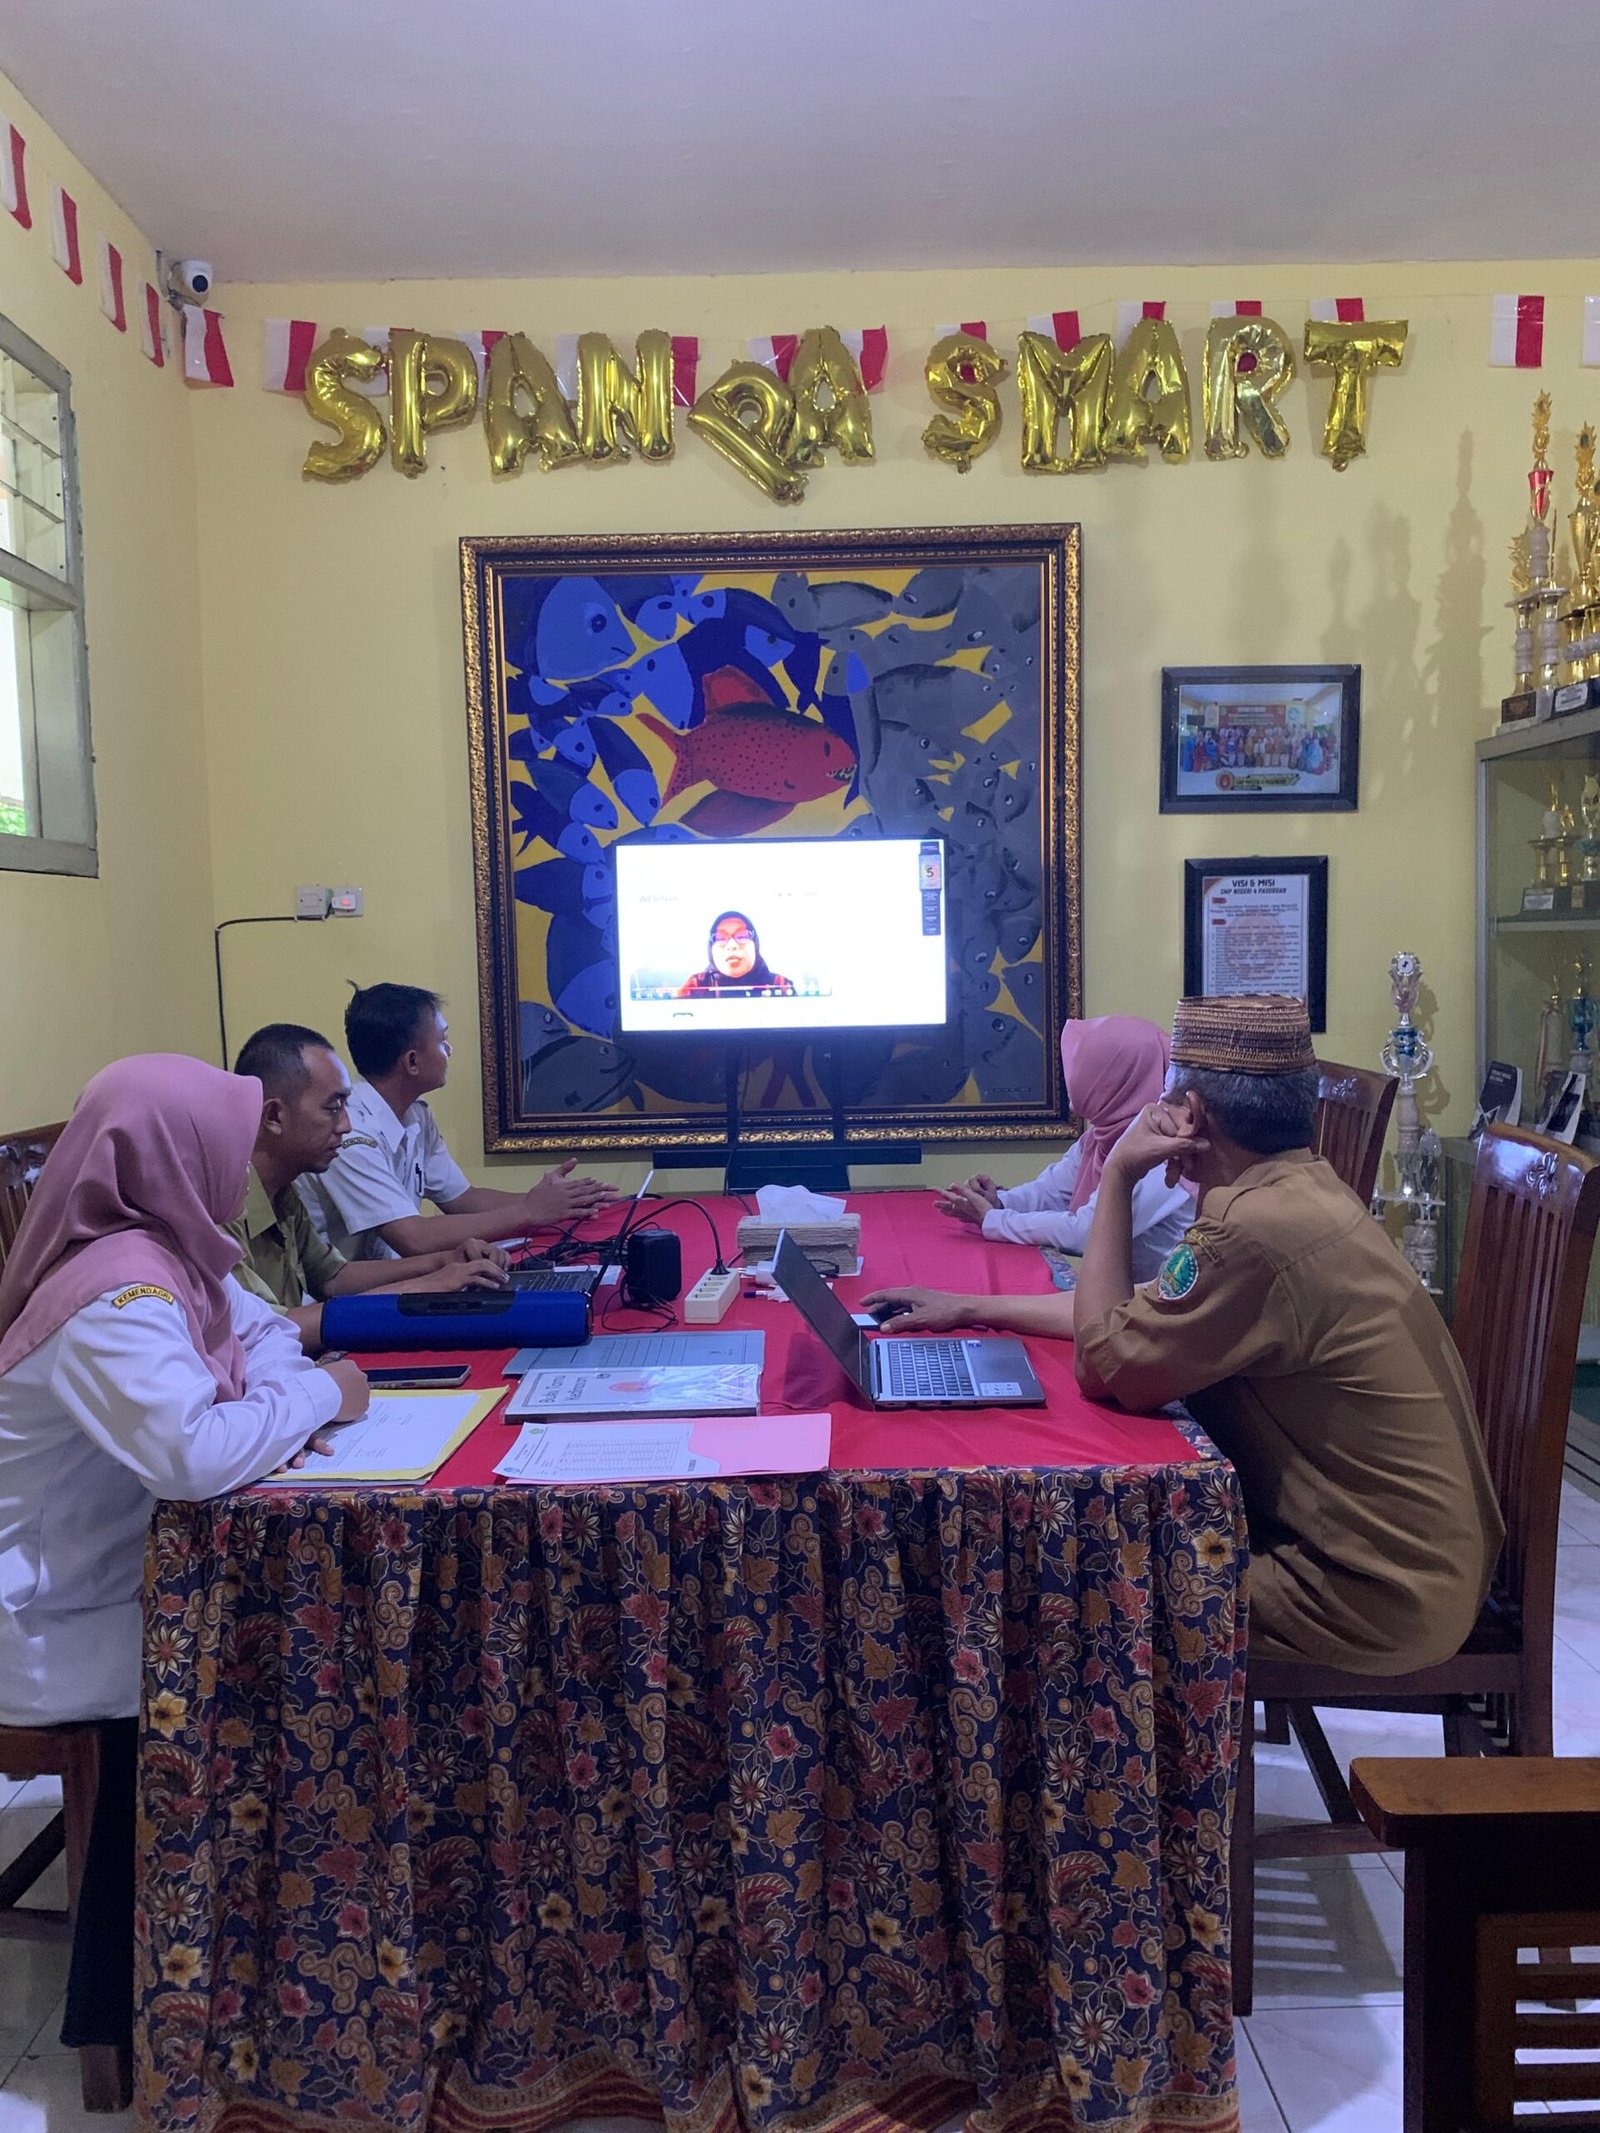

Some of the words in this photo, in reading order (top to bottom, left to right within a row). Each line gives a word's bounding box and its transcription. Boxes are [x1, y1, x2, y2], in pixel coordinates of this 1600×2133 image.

[921, 315, 1408, 473] SMART
[926, 867, 934, 878] 5
[1232, 879, 1248, 888] VISI
[1257, 879, 1276, 887] MISI
[117, 1287, 171, 1304] KEMENDAGRI
